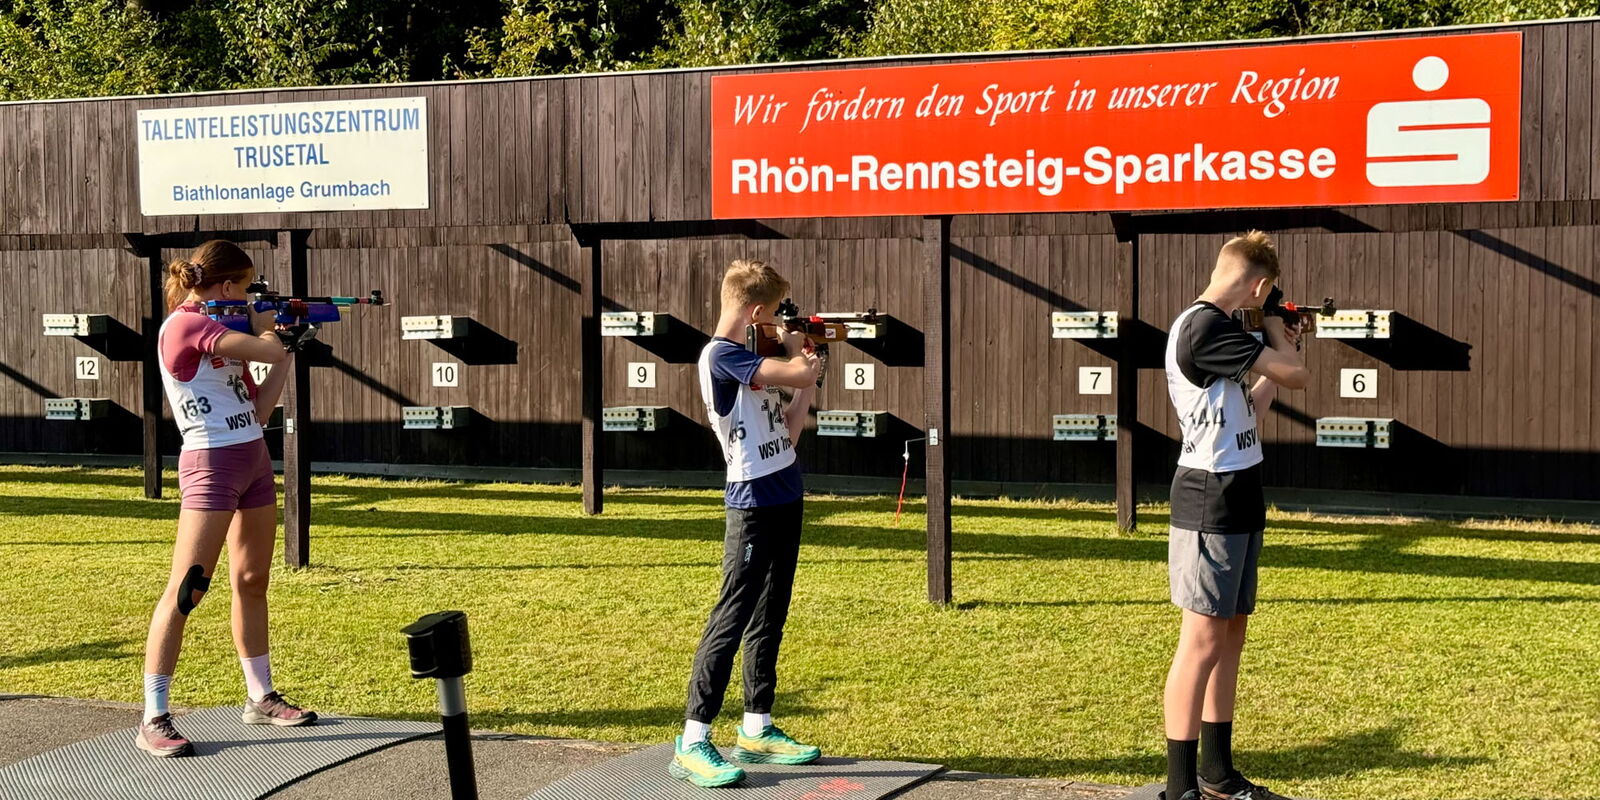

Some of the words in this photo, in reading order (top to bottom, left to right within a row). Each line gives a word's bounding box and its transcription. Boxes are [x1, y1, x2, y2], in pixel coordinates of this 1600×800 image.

[733, 94, 788, 125] Wir
[799, 87, 905, 133] fördern
[915, 83, 965, 118] den
[975, 83, 1056, 127] Sport
[1066, 79, 1097, 112] in
[1107, 79, 1218, 110] unserer
[1230, 68, 1341, 118] Region
[142, 107, 420, 141] TALENTELEISTUNGSZENTRUM
[234, 143, 330, 168] TRUSETAL
[731, 143, 1337, 196] Rhön-Rennsteig-Sparkasse
[173, 182, 295, 203] Biathlonanlage
[300, 179, 391, 198] Grumbach
[78, 360, 96, 376] 12
[253, 365, 269, 381] 11
[436, 366, 454, 384] 10
[636, 366, 648, 384] 9
[854, 367, 866, 386] 8
[1089, 371, 1103, 390] 7
[1351, 373, 1366, 393] 6
[181, 396, 212, 419] 153
[225, 411, 252, 431] WSV
[758, 438, 780, 460] WSV
[1235, 427, 1257, 451] WSV
